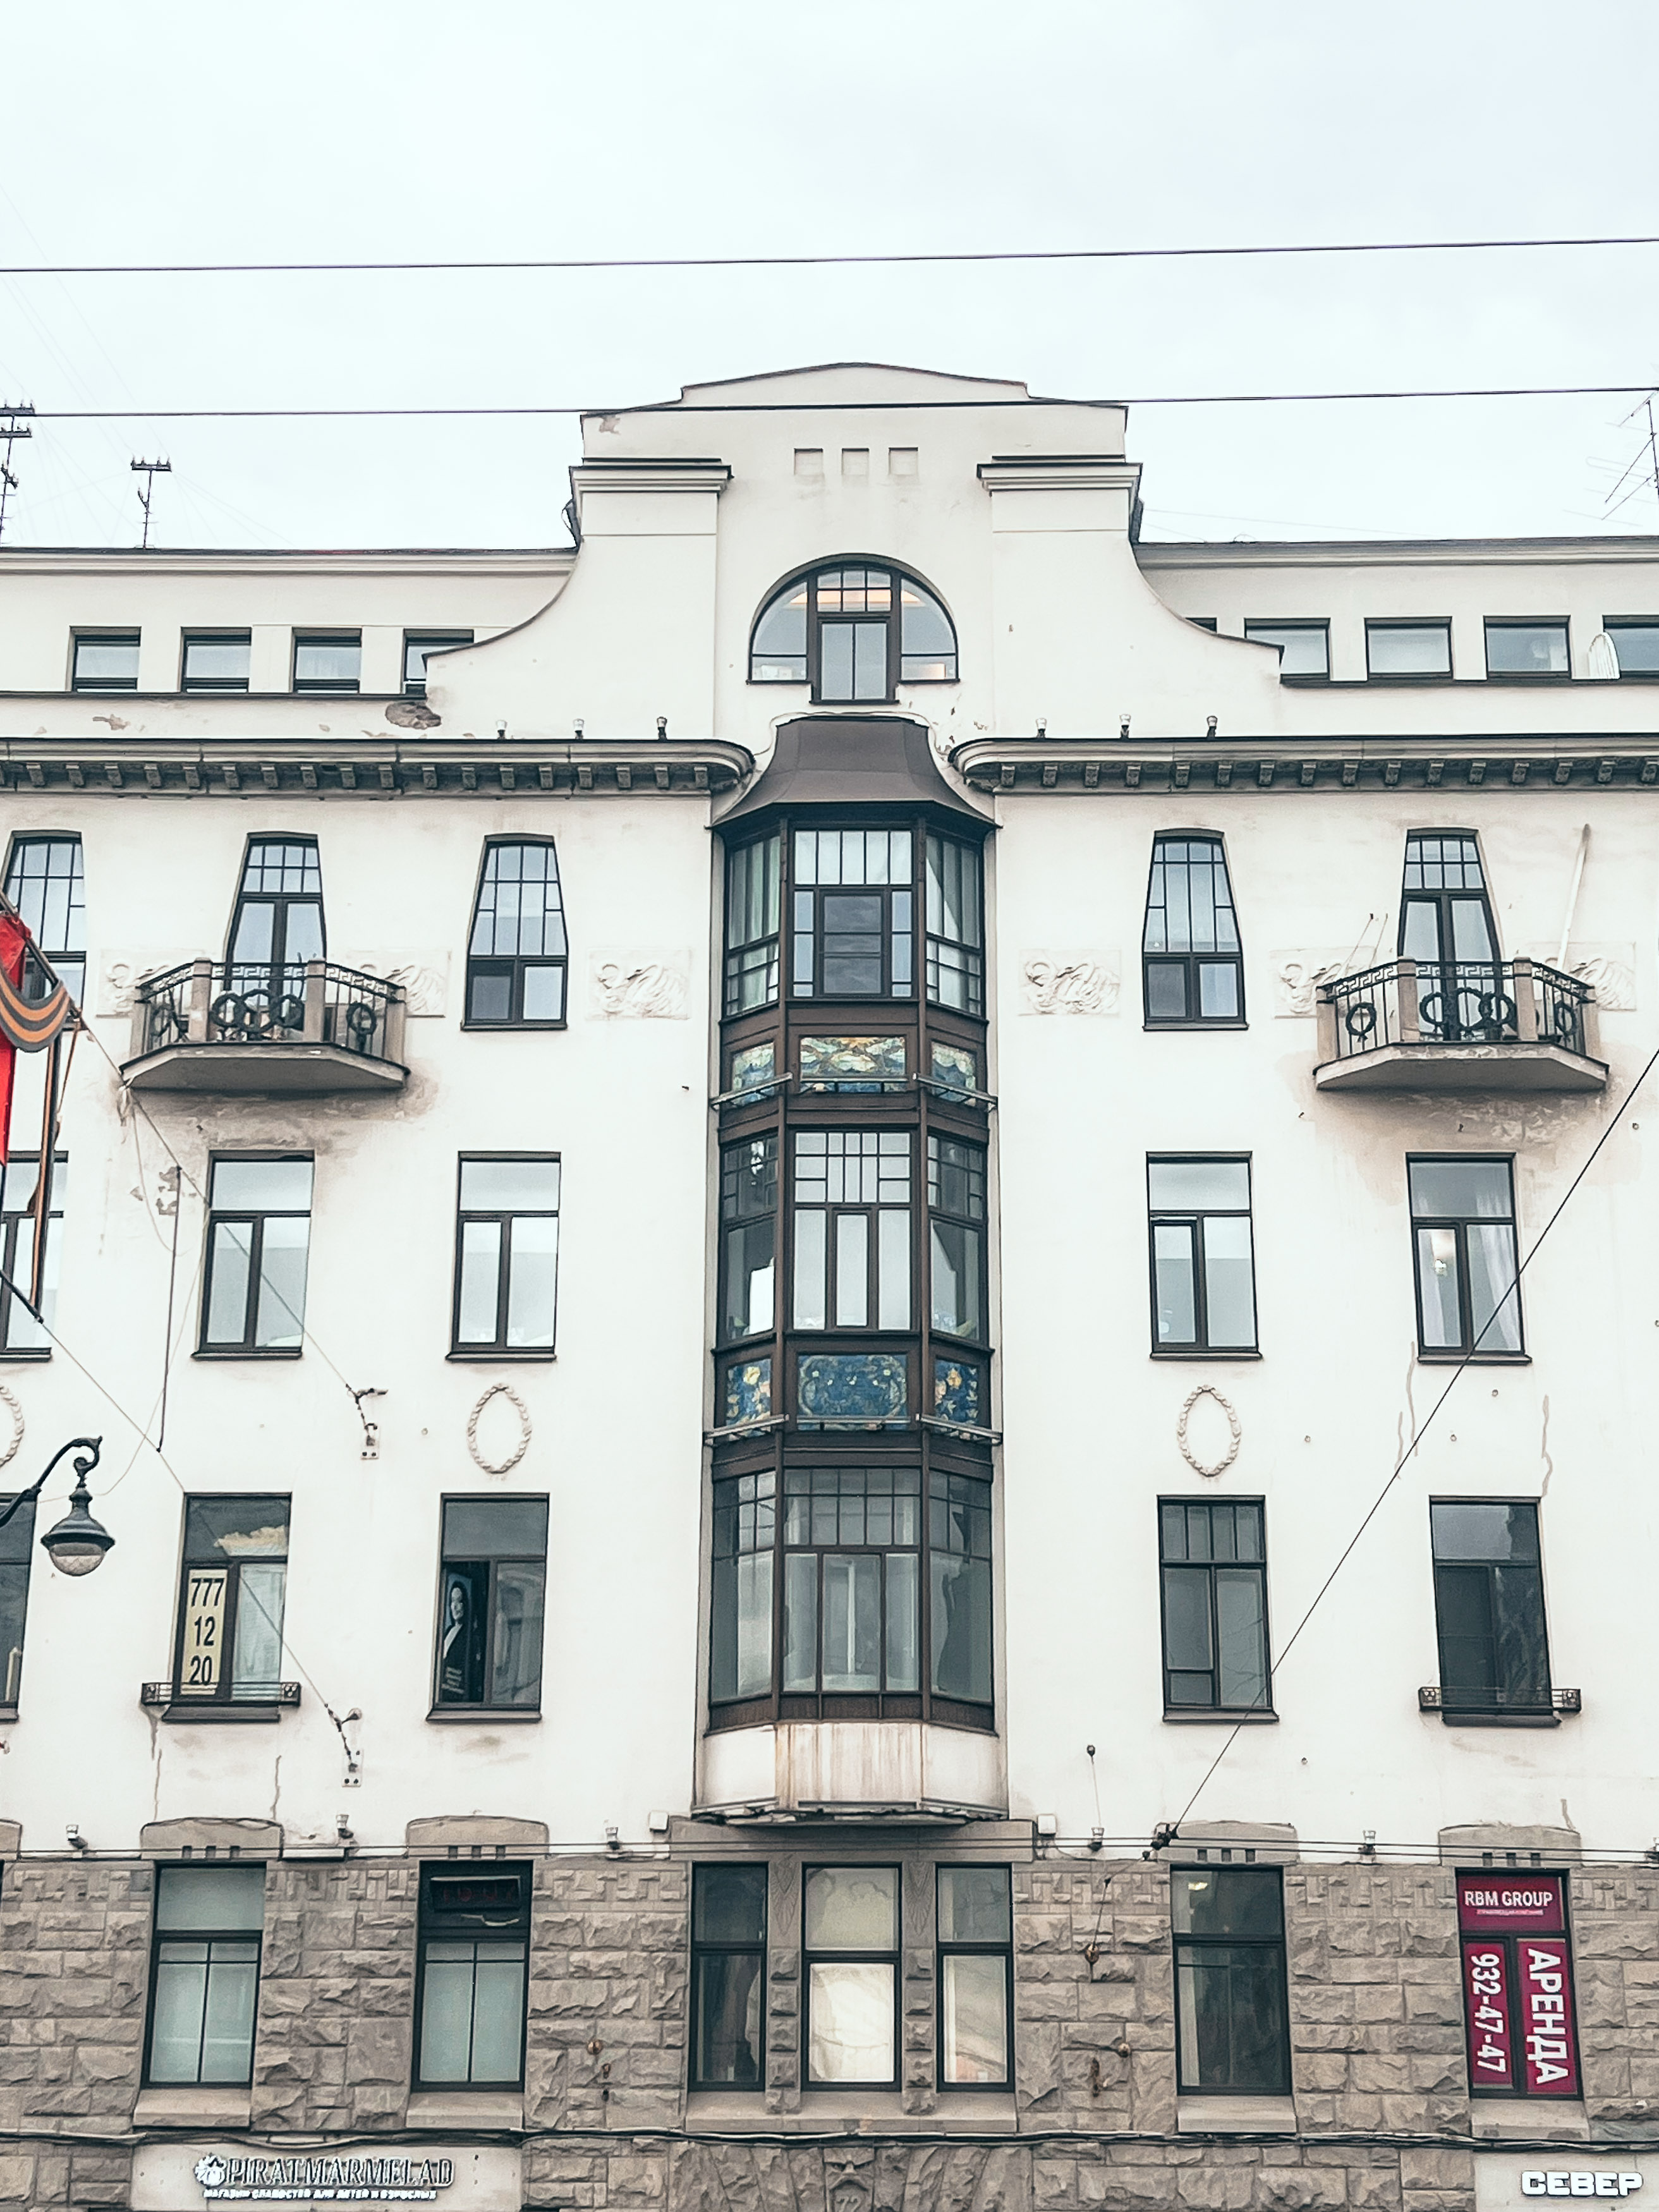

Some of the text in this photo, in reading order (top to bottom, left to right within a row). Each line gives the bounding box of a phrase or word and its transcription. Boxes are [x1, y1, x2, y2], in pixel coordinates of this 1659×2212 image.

[191, 1577, 224, 1607] 777
[195, 1615, 216, 1646] 12
[189, 1655, 212, 1686] 20
[1464, 1890, 1553, 1907] RBM GROUP
[1471, 1954, 1506, 2073] 932-47-47
[1526, 1948, 1569, 2084] АРЕНДА
[1521, 2171, 1643, 2196] СЕВЕР
